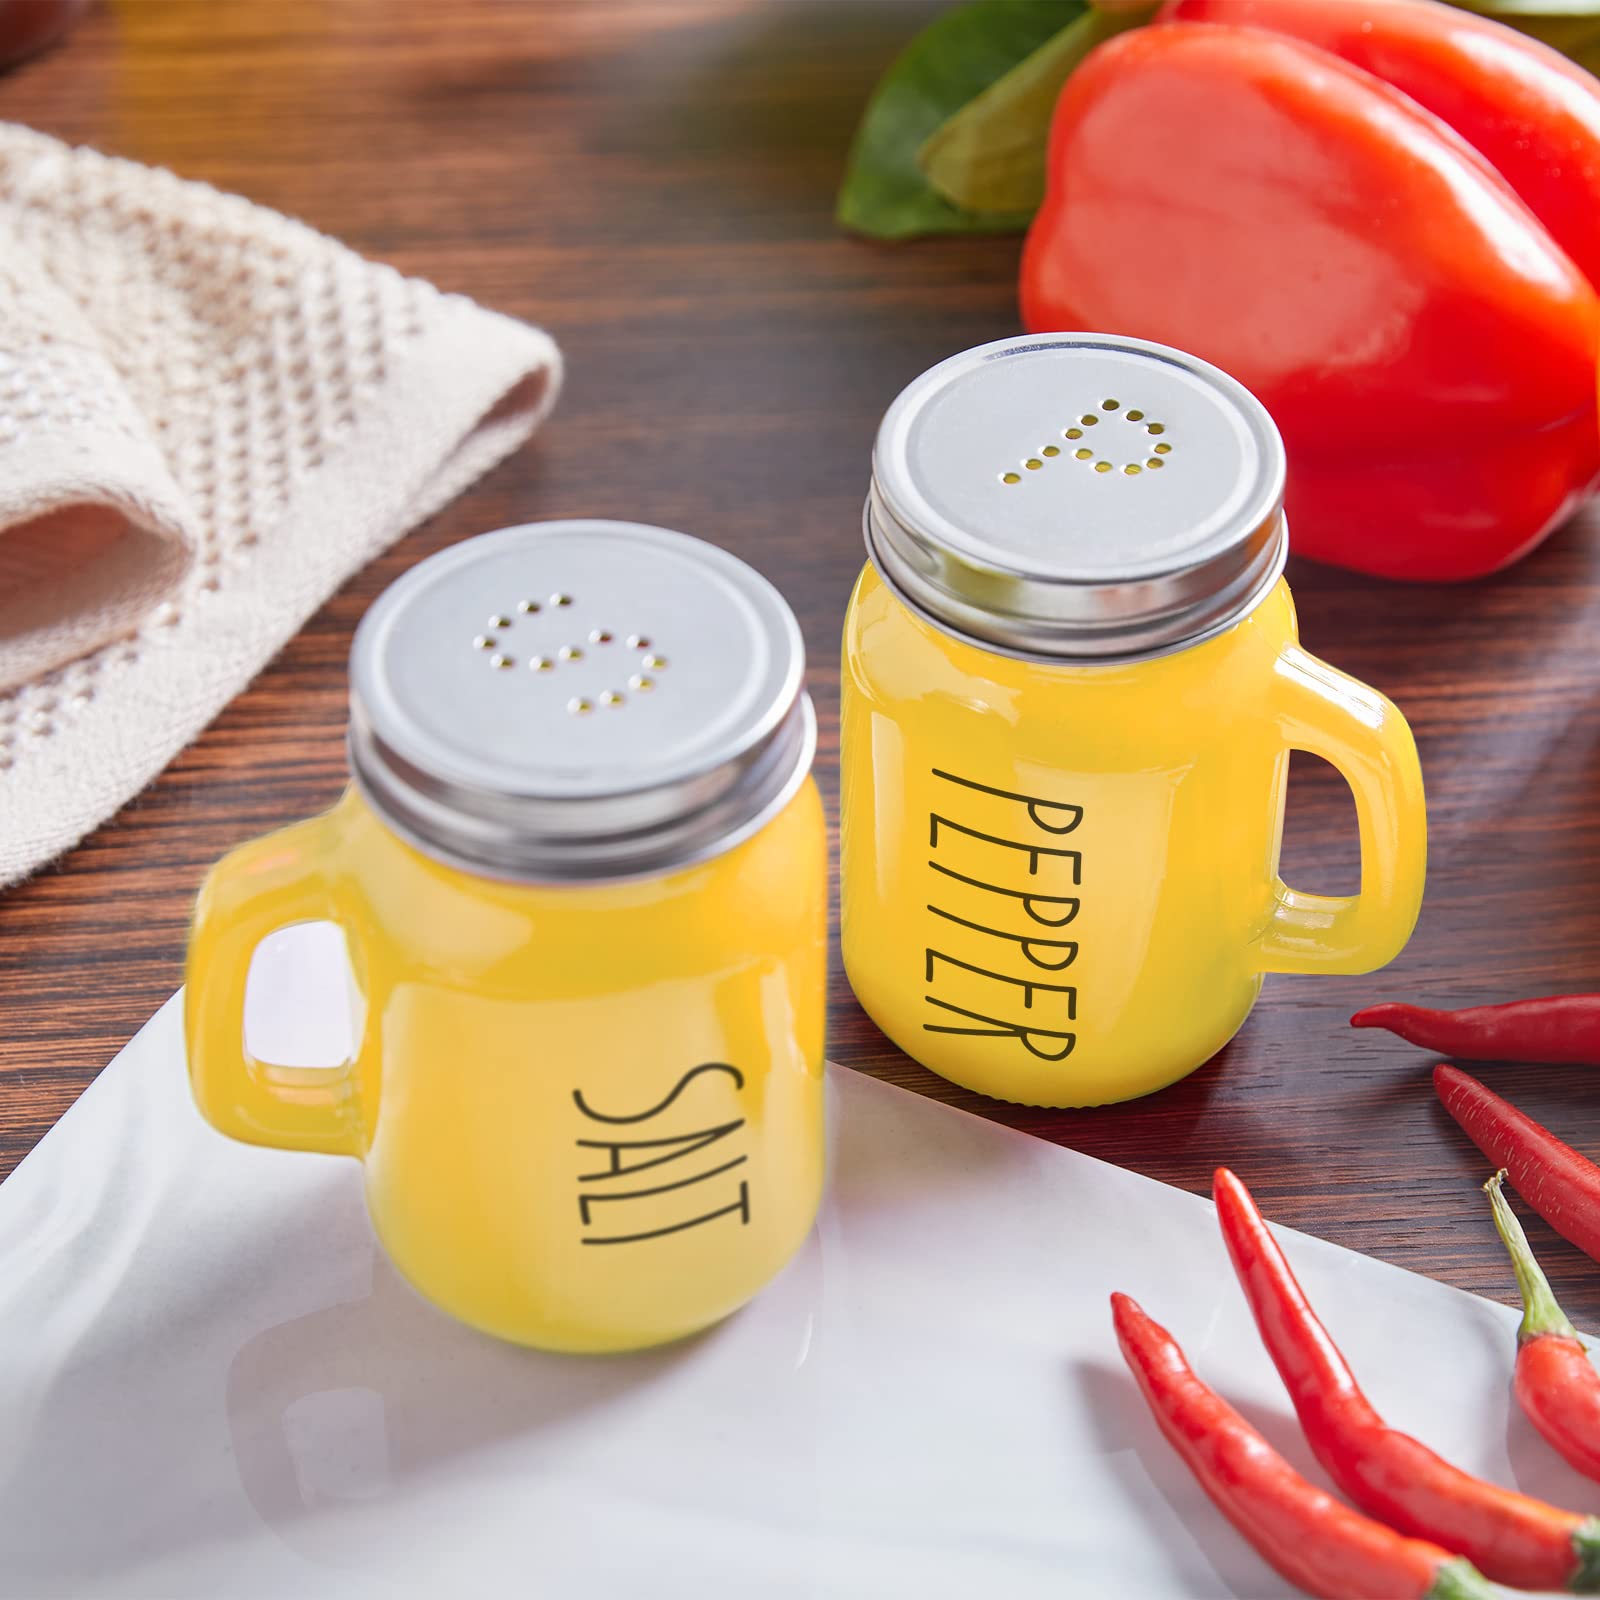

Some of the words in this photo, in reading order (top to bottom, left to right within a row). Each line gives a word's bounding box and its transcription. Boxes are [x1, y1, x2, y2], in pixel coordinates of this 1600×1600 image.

[998, 398, 1173, 485] P
[473, 591, 668, 715] S
[922, 767, 1084, 1063] PEPPER
[572, 1062, 750, 1246] SALT
